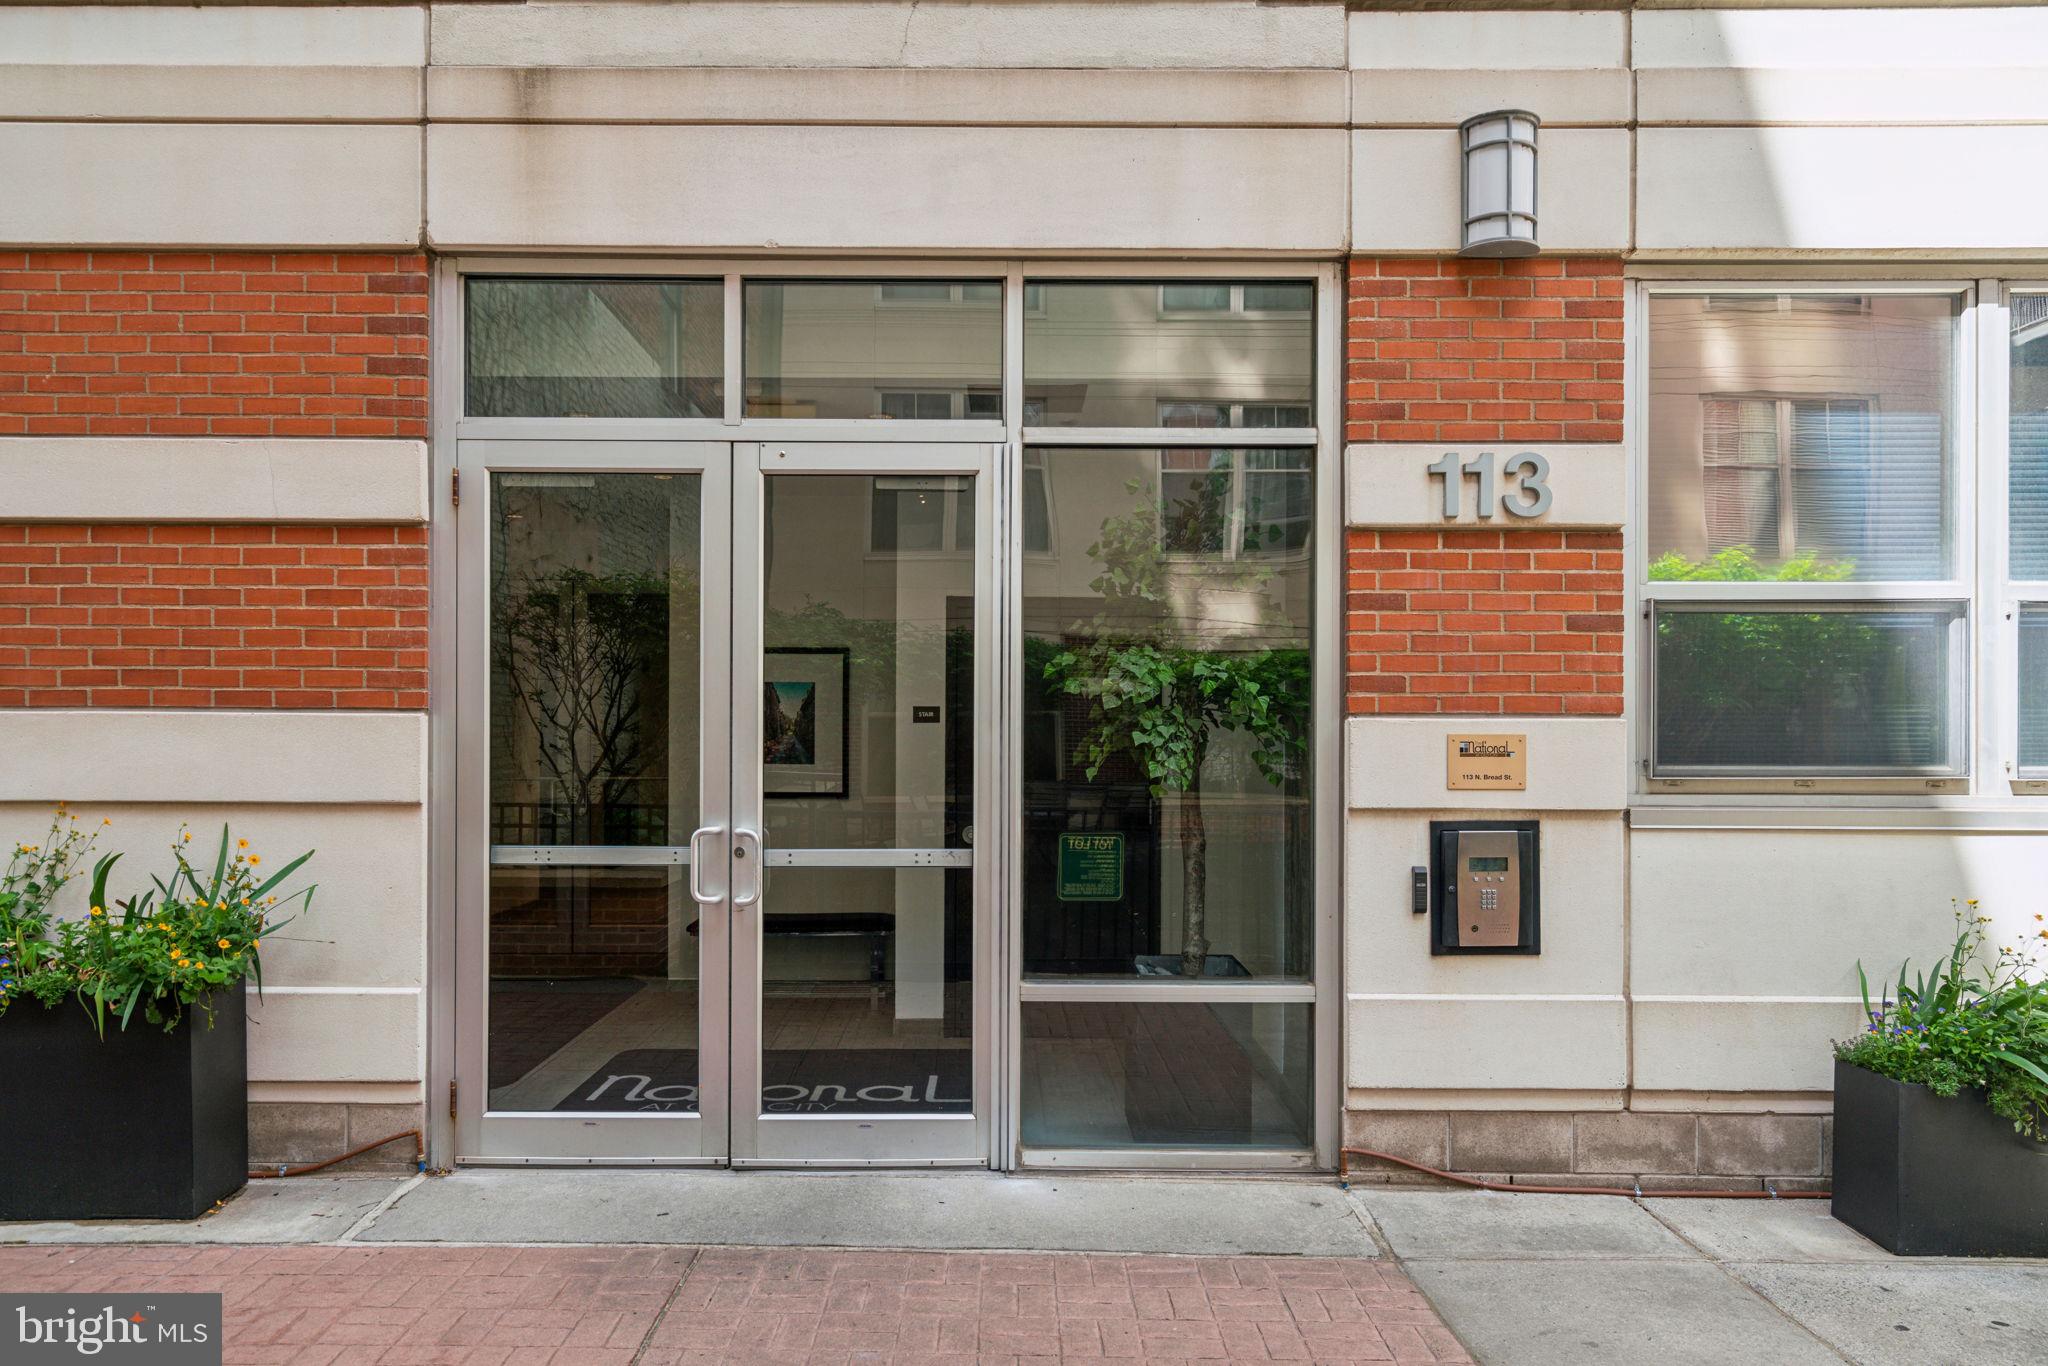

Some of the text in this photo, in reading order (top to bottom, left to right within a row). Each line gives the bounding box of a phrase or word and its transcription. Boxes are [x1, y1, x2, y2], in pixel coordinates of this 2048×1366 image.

[1427, 451, 1553, 518] 113
[638, 1103, 677, 1111] AT
[767, 1102, 838, 1112] CITY
